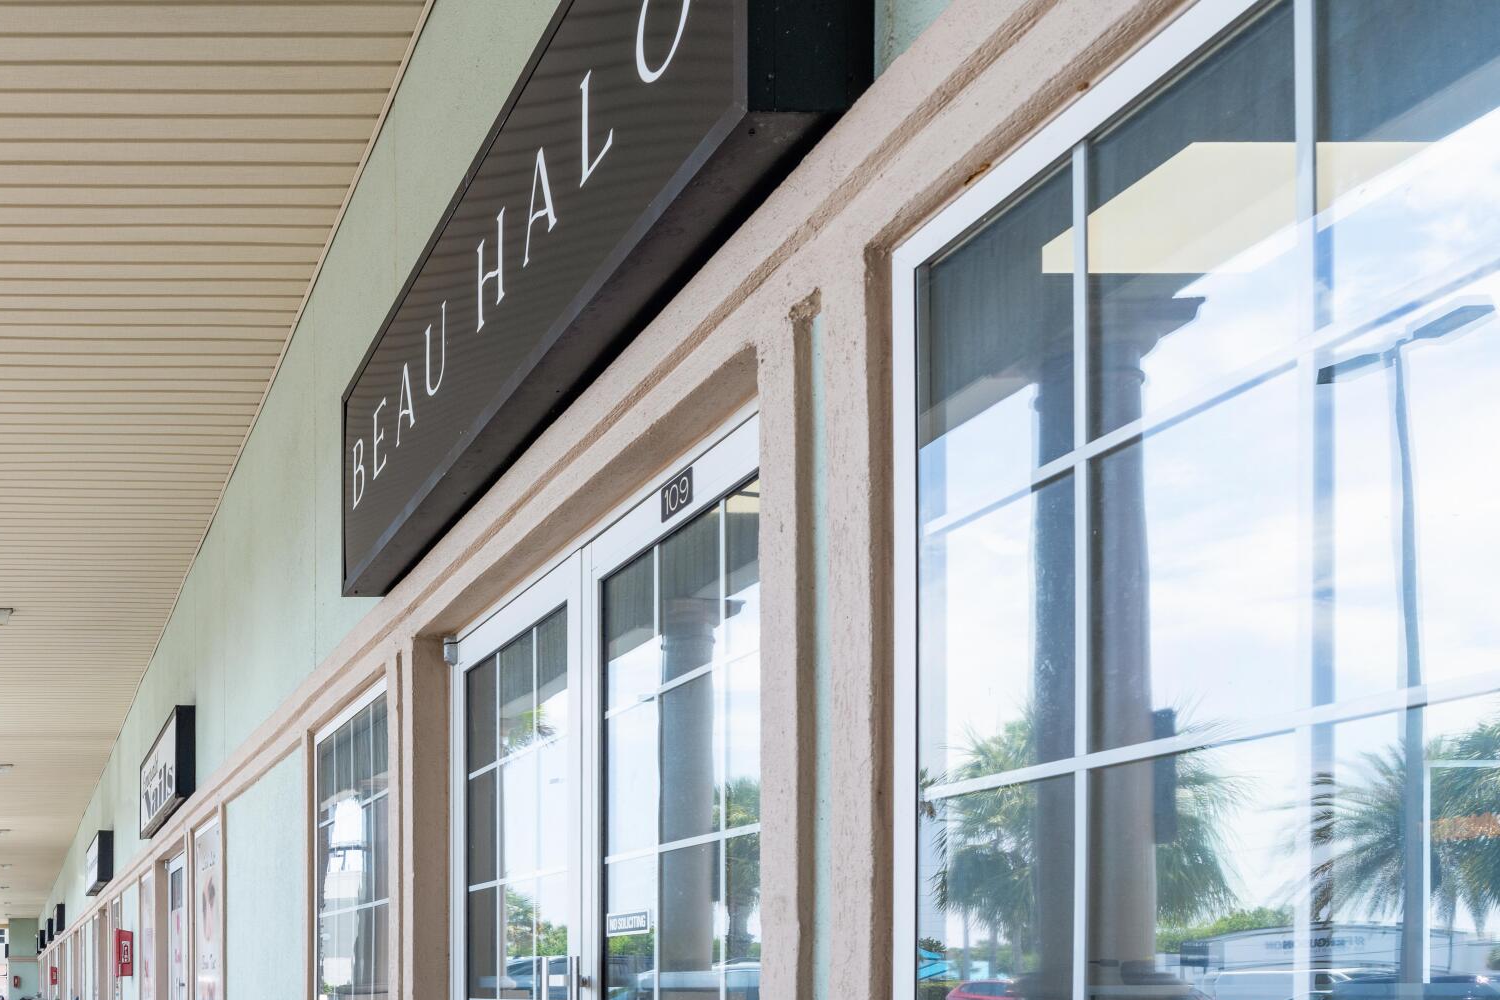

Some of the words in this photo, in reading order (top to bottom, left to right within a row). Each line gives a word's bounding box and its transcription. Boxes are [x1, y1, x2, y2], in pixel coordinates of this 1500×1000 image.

[353, 301, 446, 511] BEAU
[663, 476, 690, 517] 109
[142, 761, 173, 825] Nails
[609, 918, 617, 931] NO
[618, 914, 646, 930] SOLICITING
